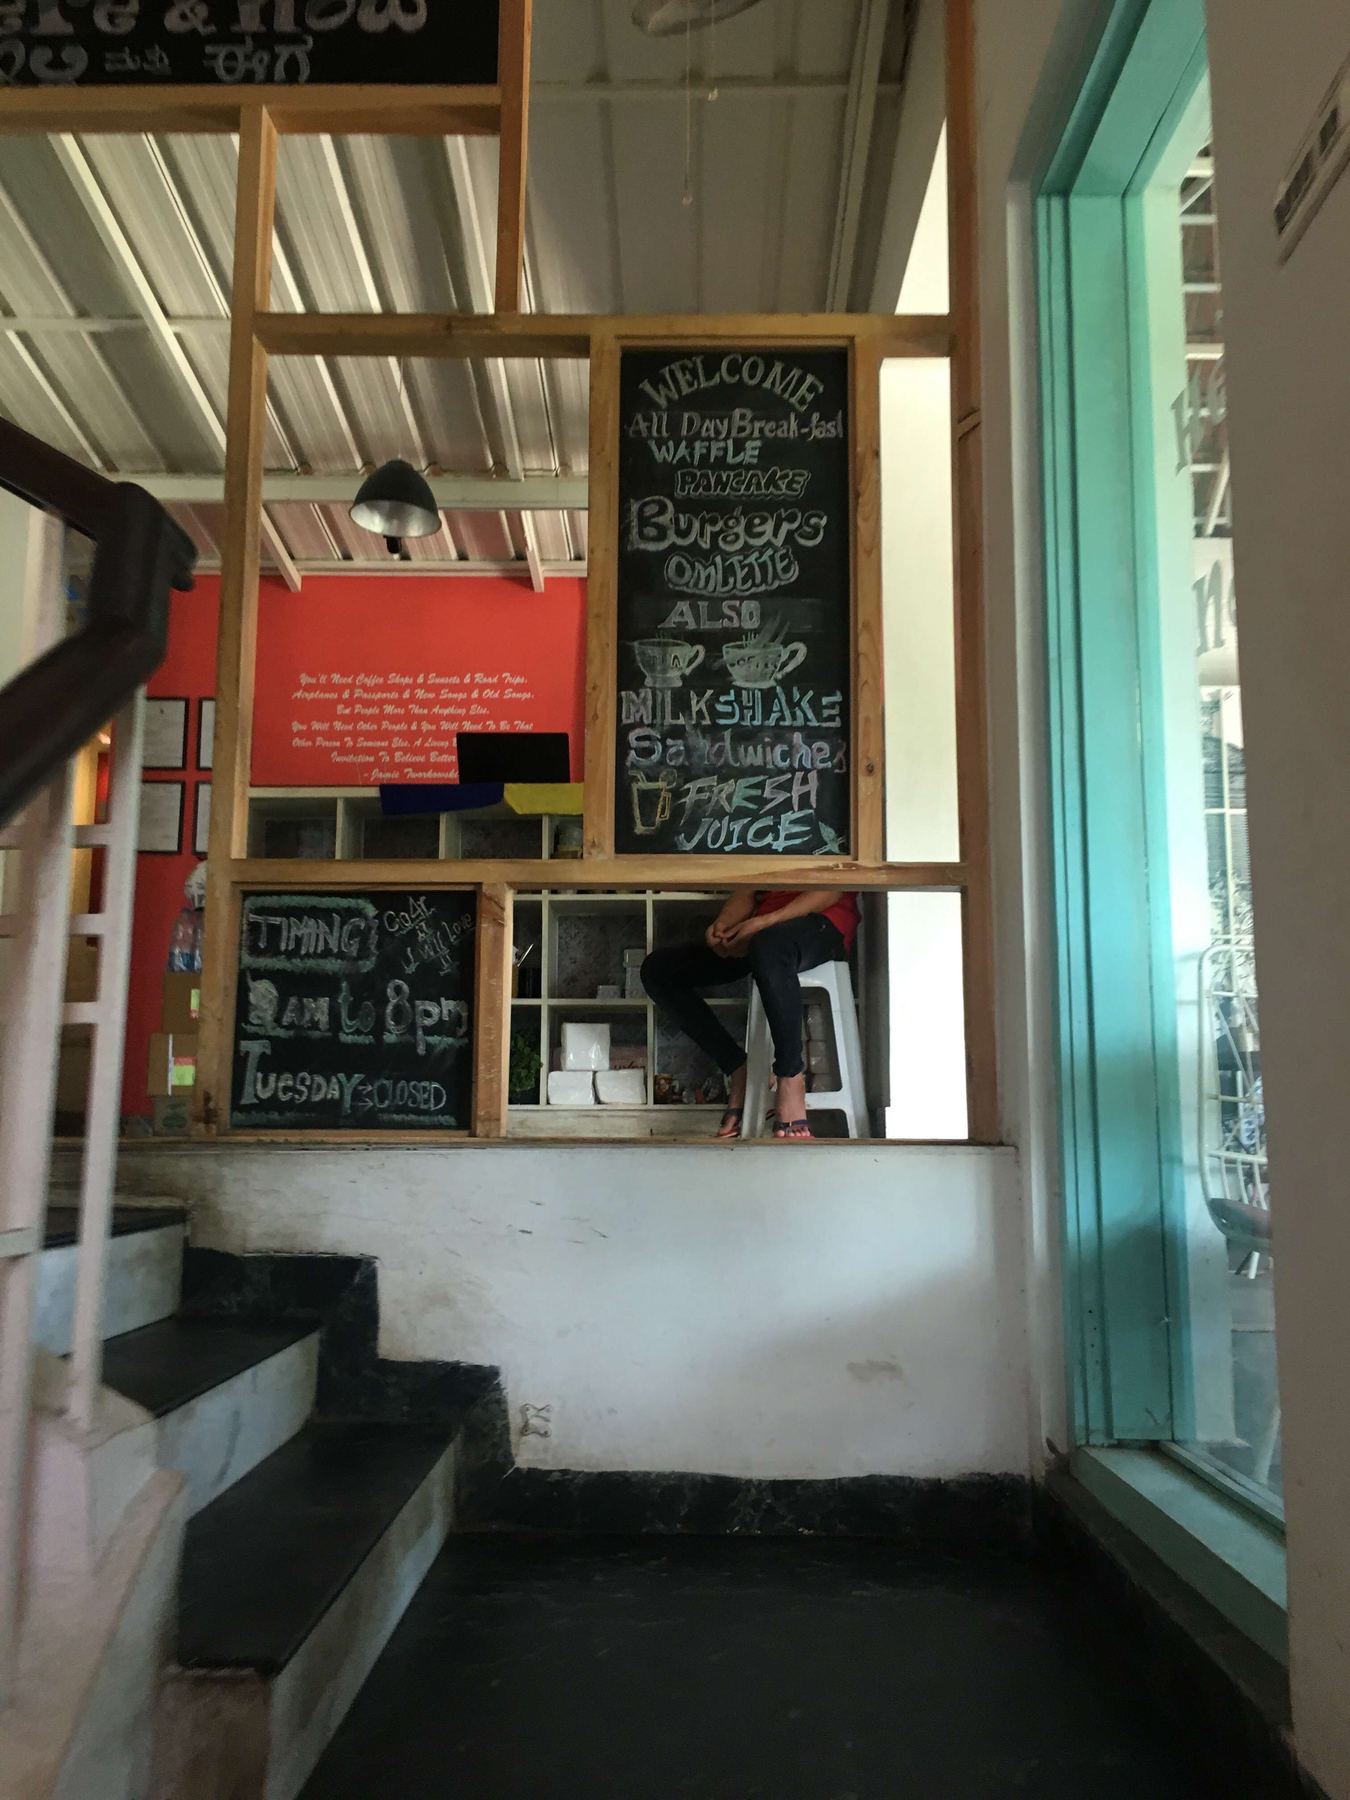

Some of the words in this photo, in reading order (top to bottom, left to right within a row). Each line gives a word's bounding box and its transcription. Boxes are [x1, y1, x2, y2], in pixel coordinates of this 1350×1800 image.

[639, 353, 825, 412] WELCOME
[629, 411, 669, 438] All
[648, 438, 763, 465] WAFFLE
[674, 466, 812, 499] PANCAKE
[627, 496, 828, 553] Burgers
[657, 599, 761, 630] ALSO
[331, 673, 354, 684] Need
[356, 673, 384, 686] Coffee
[387, 673, 414, 686] Shops
[417, 673, 425, 684] &
[428, 673, 460, 684] Sunsets
[463, 673, 471, 684] &
[474, 673, 499, 684] Road
[292, 689, 339, 701] Airplanes
[342, 689, 350, 699] &
[354, 689, 399, 701] Passports
[402, 689, 411, 699] &
[414, 689, 436, 699] New
[440, 689, 467, 701] Songs
[471, 689, 479, 699] &
[482, 689, 501, 699] Old
[336, 704, 352, 715] But
[354, 704, 380, 716] People
[383, 704, 406, 715] More
[408, 704, 428, 715] Than
[431, 704, 466, 717] Anything
[291, 720, 308, 733] You
[311, 720, 330, 731] Will
[333, 720, 354, 731] Need
[356, 720, 378, 731] Other
[381, 720, 408, 732] People
[410, 720, 418, 731] &
[421, 720, 437, 733] You
[440, 720, 459, 731] Will
[462, 720, 482, 731] Need
[486, 720, 497, 731] To
[499, 720, 511, 731] Be
[513, 720, 534, 731] That
[292, 737, 312, 748] Other
[315, 737, 341, 748] Person
[344, 737, 354, 748] To
[356, 737, 389, 748] Someone
[413, 737, 423, 748] A
[331, 752, 375, 763] Invitation
[379, 752, 390, 763] To
[394, 752, 426, 763] Believe
[430, 752, 457, 763] Better
[672, 770, 819, 827] FRESH
[676, 810, 816, 853] JUICE
[338, 981, 376, 1034] to
[373, 1078, 447, 1112] CLOSED
